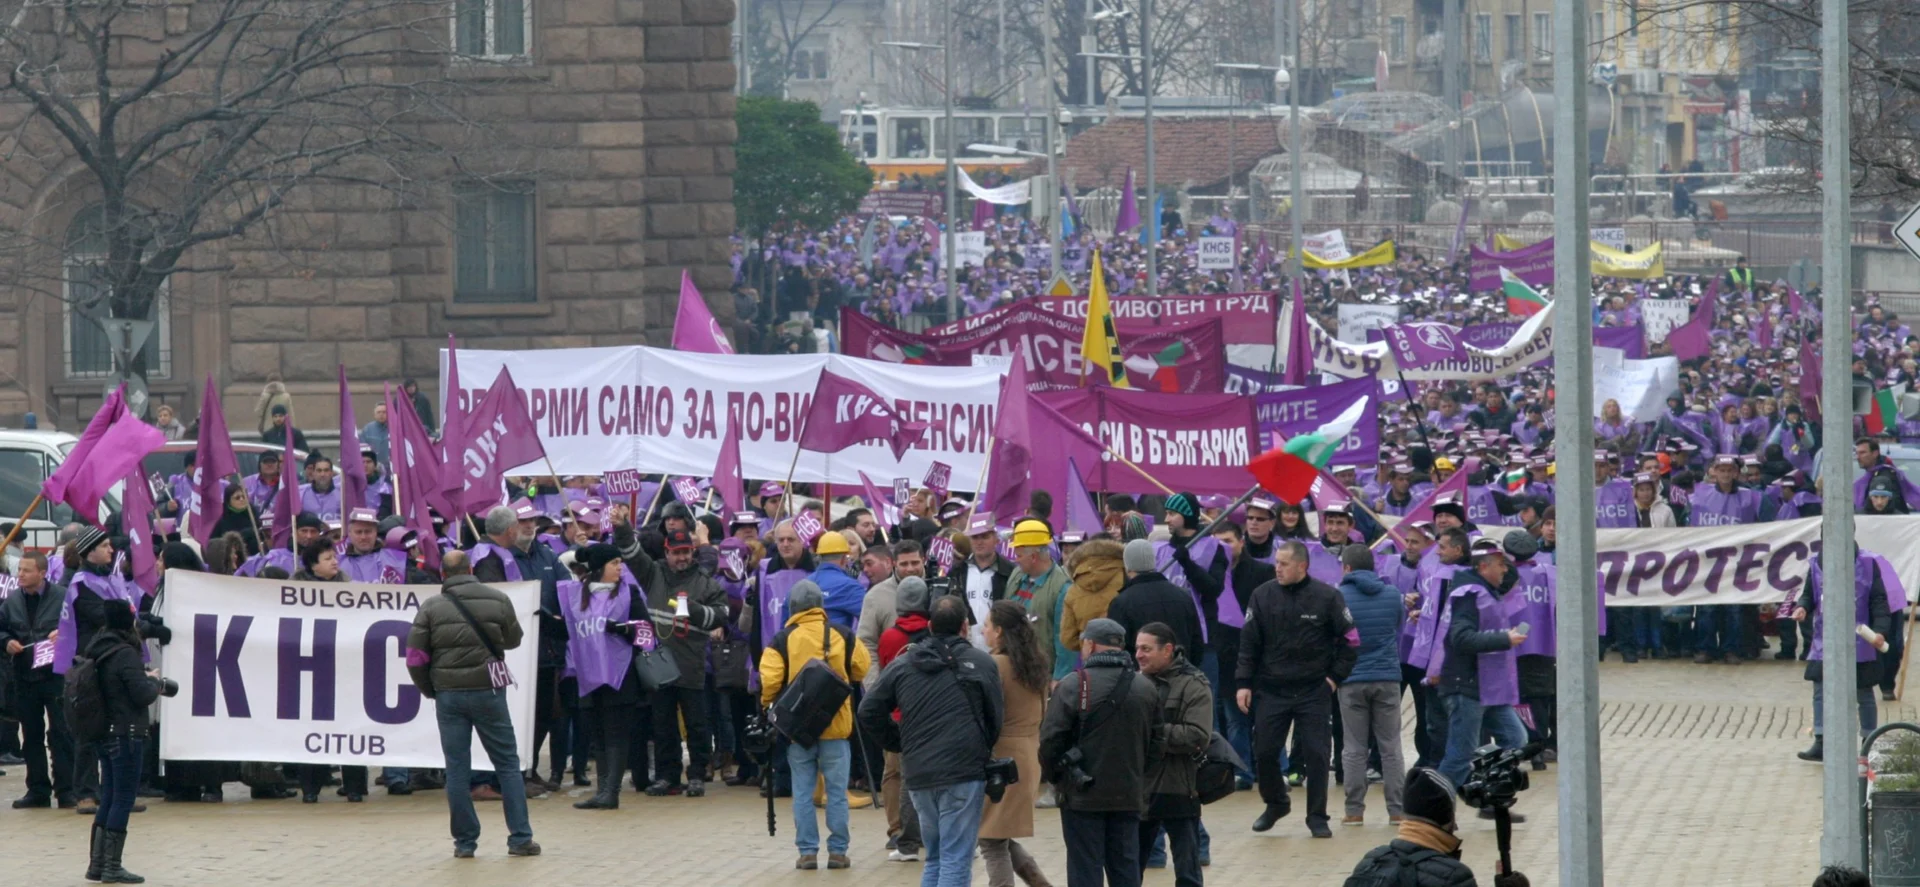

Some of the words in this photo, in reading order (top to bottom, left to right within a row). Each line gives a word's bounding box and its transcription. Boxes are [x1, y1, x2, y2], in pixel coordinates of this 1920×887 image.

[1202, 241, 1231, 254] КНСБ
[1063, 299, 1206, 319] ДОИВОТЕН
[1469, 323, 1517, 342] СИНД
[1312, 327, 1382, 376] НСБ
[458, 387, 589, 437] РРМИ
[598, 385, 674, 437] САМО
[682, 387, 717, 439] ЗА
[726, 391, 885, 447] ПО-ВИ
[1098, 420, 1125, 462] СИ
[1129, 423, 1144, 463] В
[1146, 426, 1251, 466] БЪЛГАРИЯ
[1295, 428, 1362, 451] СБ
[604, 472, 641, 495] КНСБ
[674, 477, 701, 504] НСБ
[1468, 504, 1489, 519] СБ
[1595, 504, 1628, 519] НСБ
[794, 509, 821, 545] НСБ
[725, 548, 744, 581] НСБ
[929, 536, 954, 569] КНС
[281, 586, 420, 611] BULGARIA
[1520, 584, 1550, 604] НСБ
[575, 615, 608, 639] КНС
[636, 622, 653, 646] НСБ
[34, 640, 55, 669] КНС
[191, 613, 423, 724] КНС
[487, 661, 511, 688] КН
[304, 732, 386, 756] CITUB
